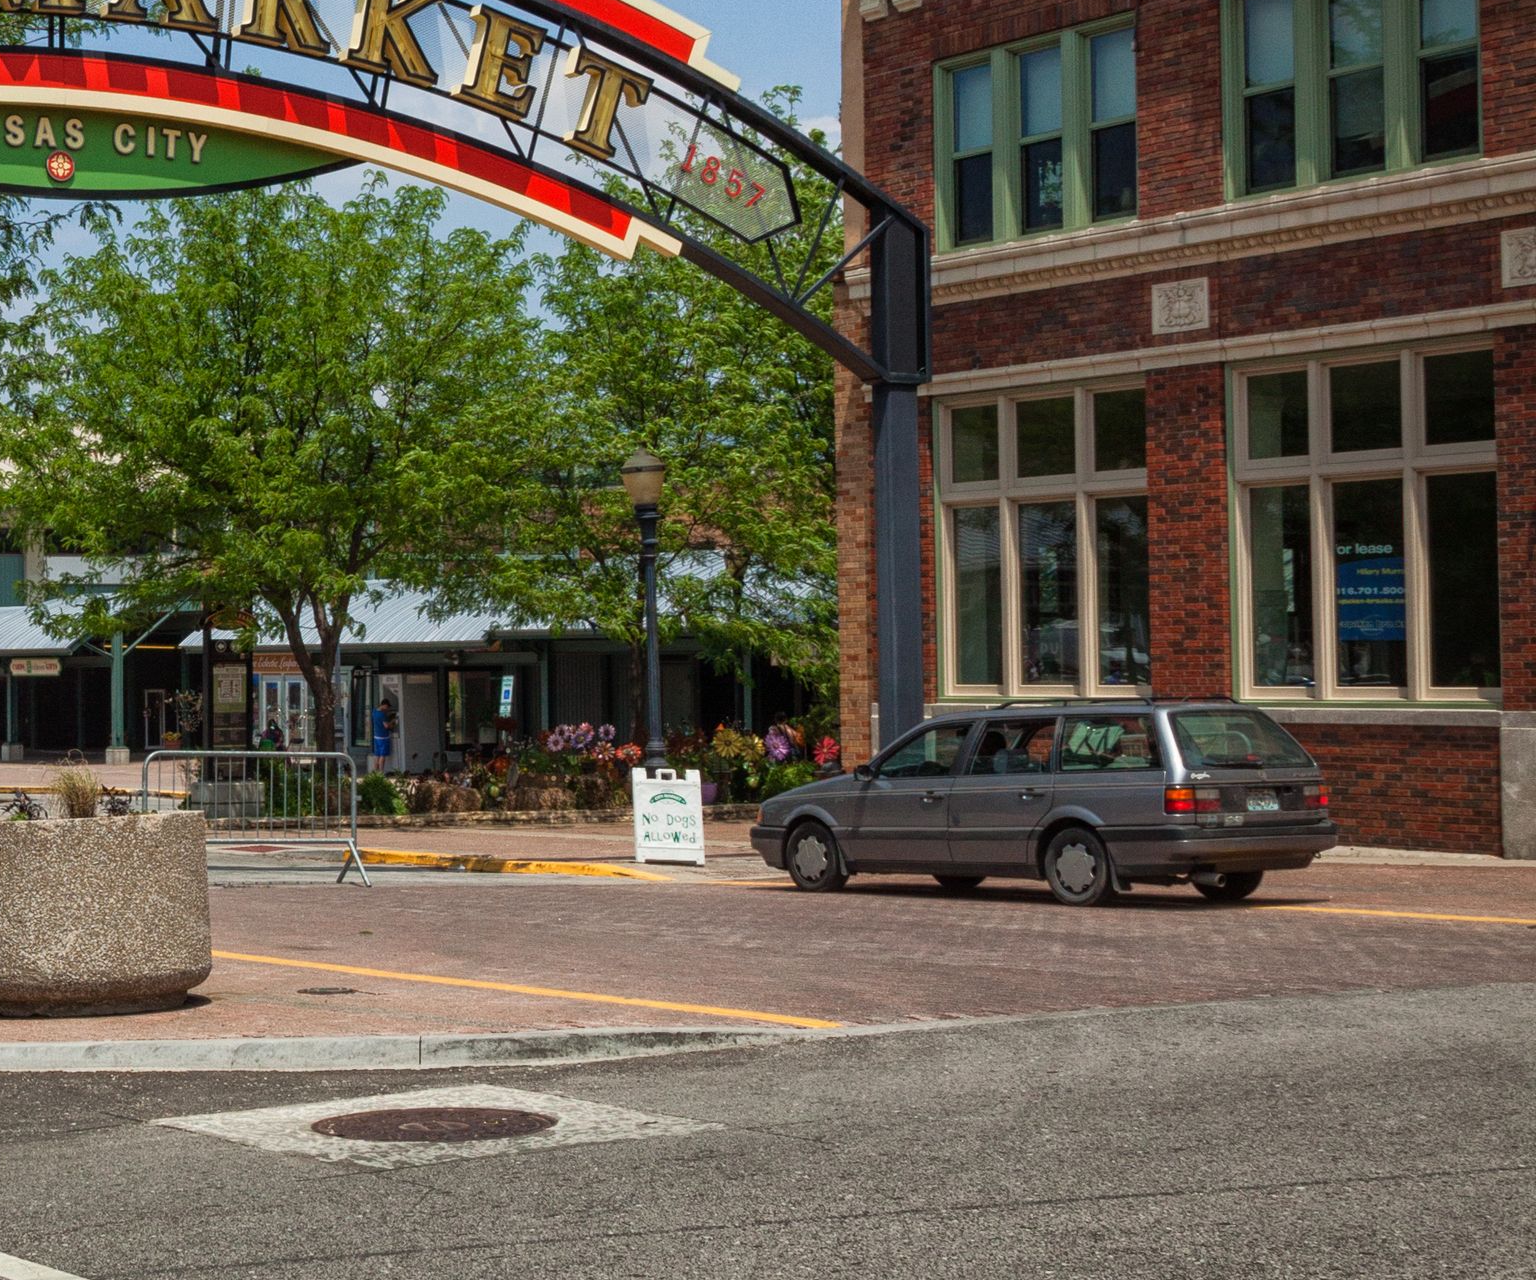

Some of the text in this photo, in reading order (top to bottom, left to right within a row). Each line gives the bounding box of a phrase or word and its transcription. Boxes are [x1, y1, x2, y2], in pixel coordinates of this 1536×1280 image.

[113, 122, 208, 164] CITY
[681, 143, 767, 208] 1857
[1336, 543, 1393, 555] or lease
[642, 813, 658, 826] No
